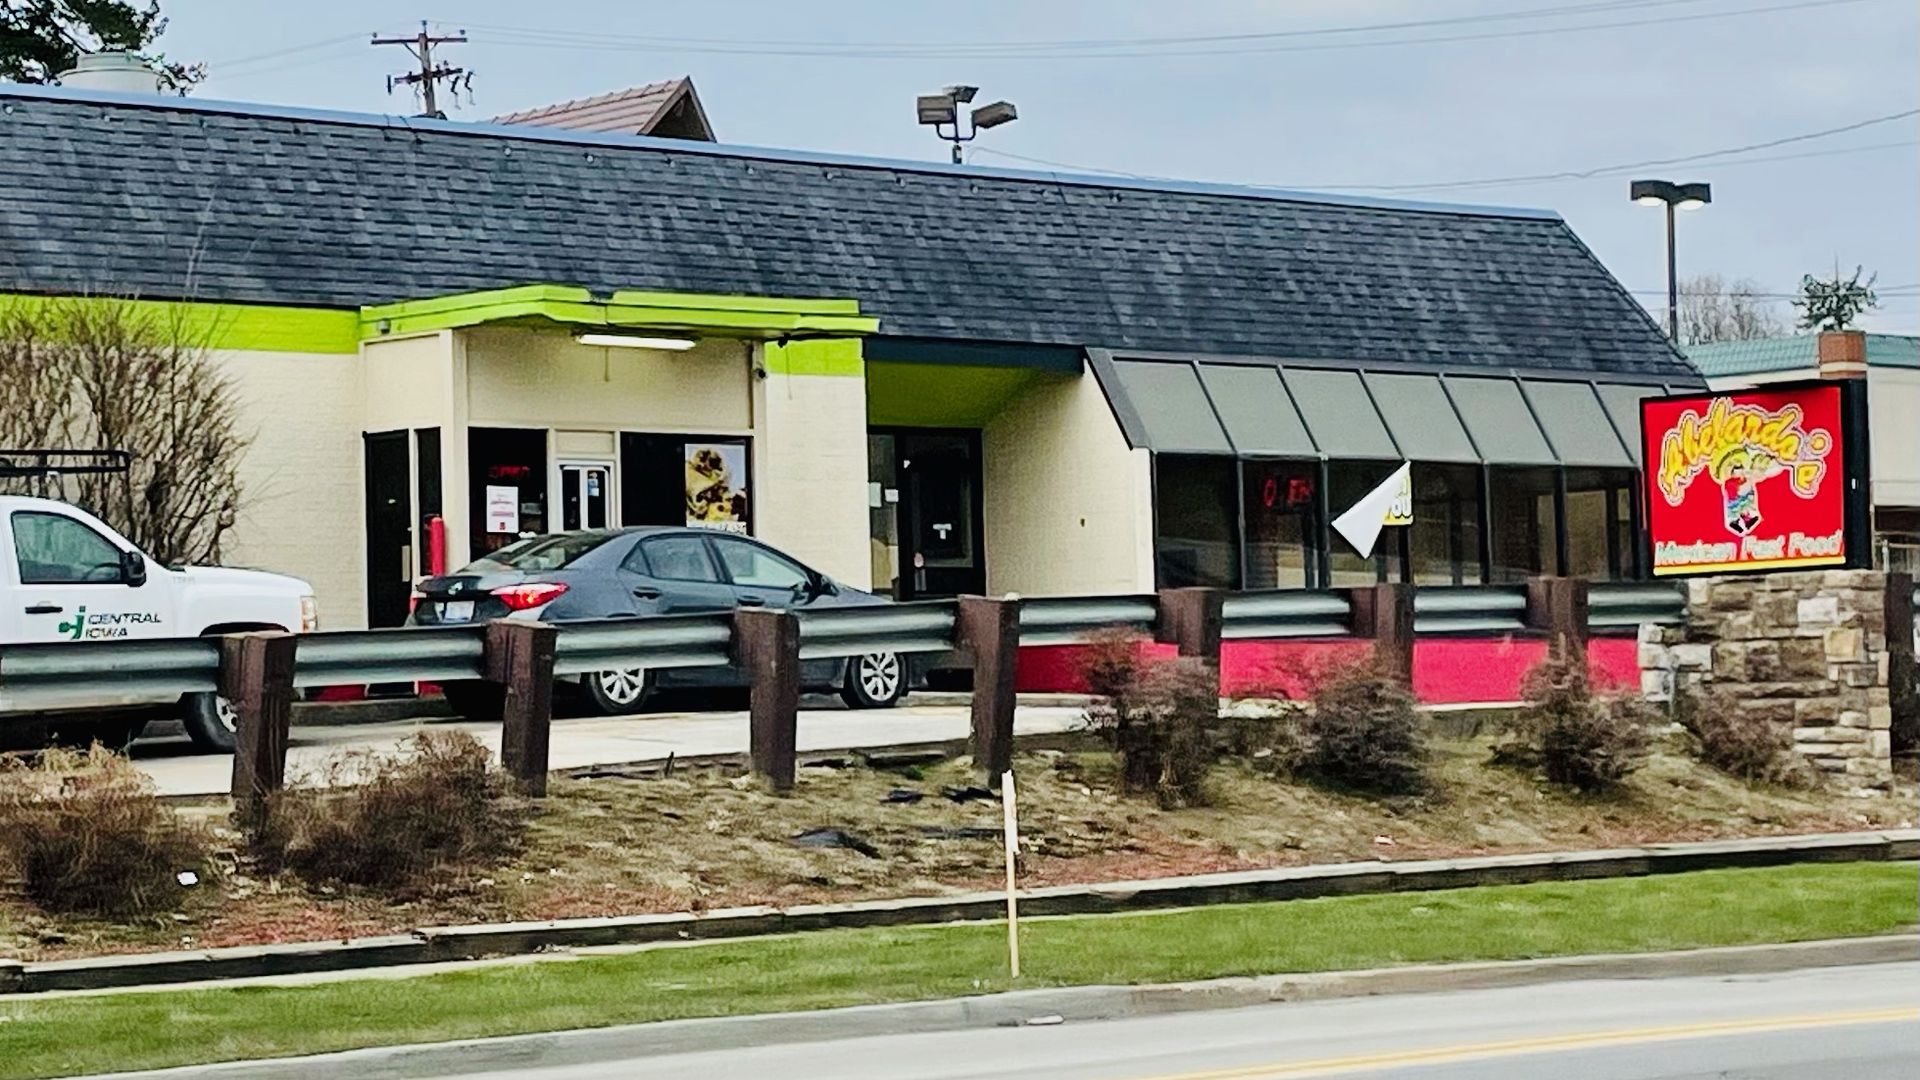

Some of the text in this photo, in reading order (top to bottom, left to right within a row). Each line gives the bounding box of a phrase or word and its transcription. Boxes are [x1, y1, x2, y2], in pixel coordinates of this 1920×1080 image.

[1655, 530, 1843, 565] Mexican Fast Food
[88, 613, 162, 625] CENTRAL
[86, 627, 128, 639] IOWA
